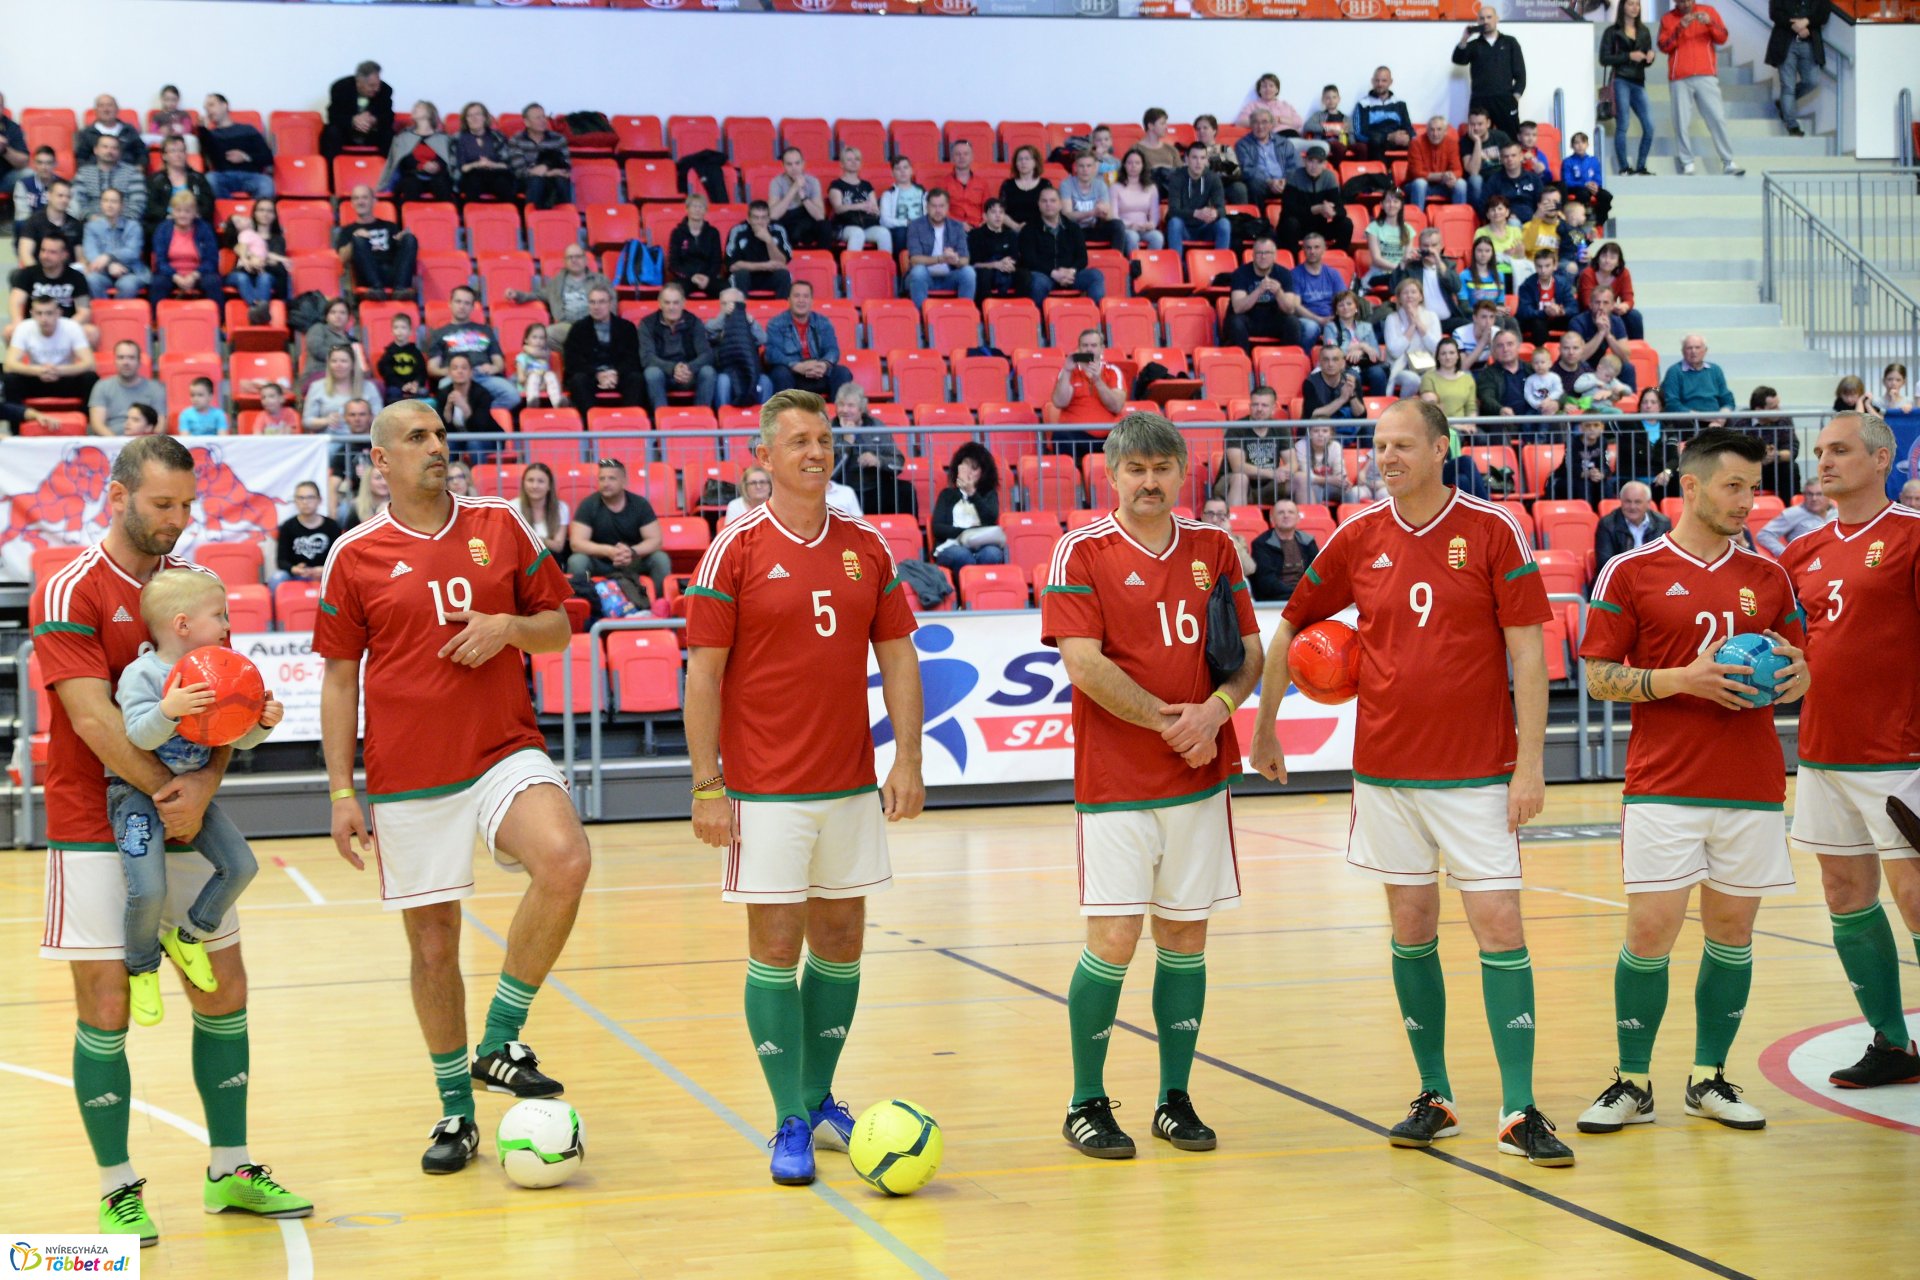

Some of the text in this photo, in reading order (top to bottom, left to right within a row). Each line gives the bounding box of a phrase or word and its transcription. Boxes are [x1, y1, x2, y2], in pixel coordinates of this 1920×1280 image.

[428, 576, 472, 625] 19
[812, 590, 837, 637] 5
[1156, 600, 1199, 647] 16
[1409, 581, 1433, 627] 9
[1827, 579, 1844, 622] 3
[1695, 611, 1735, 656] 21
